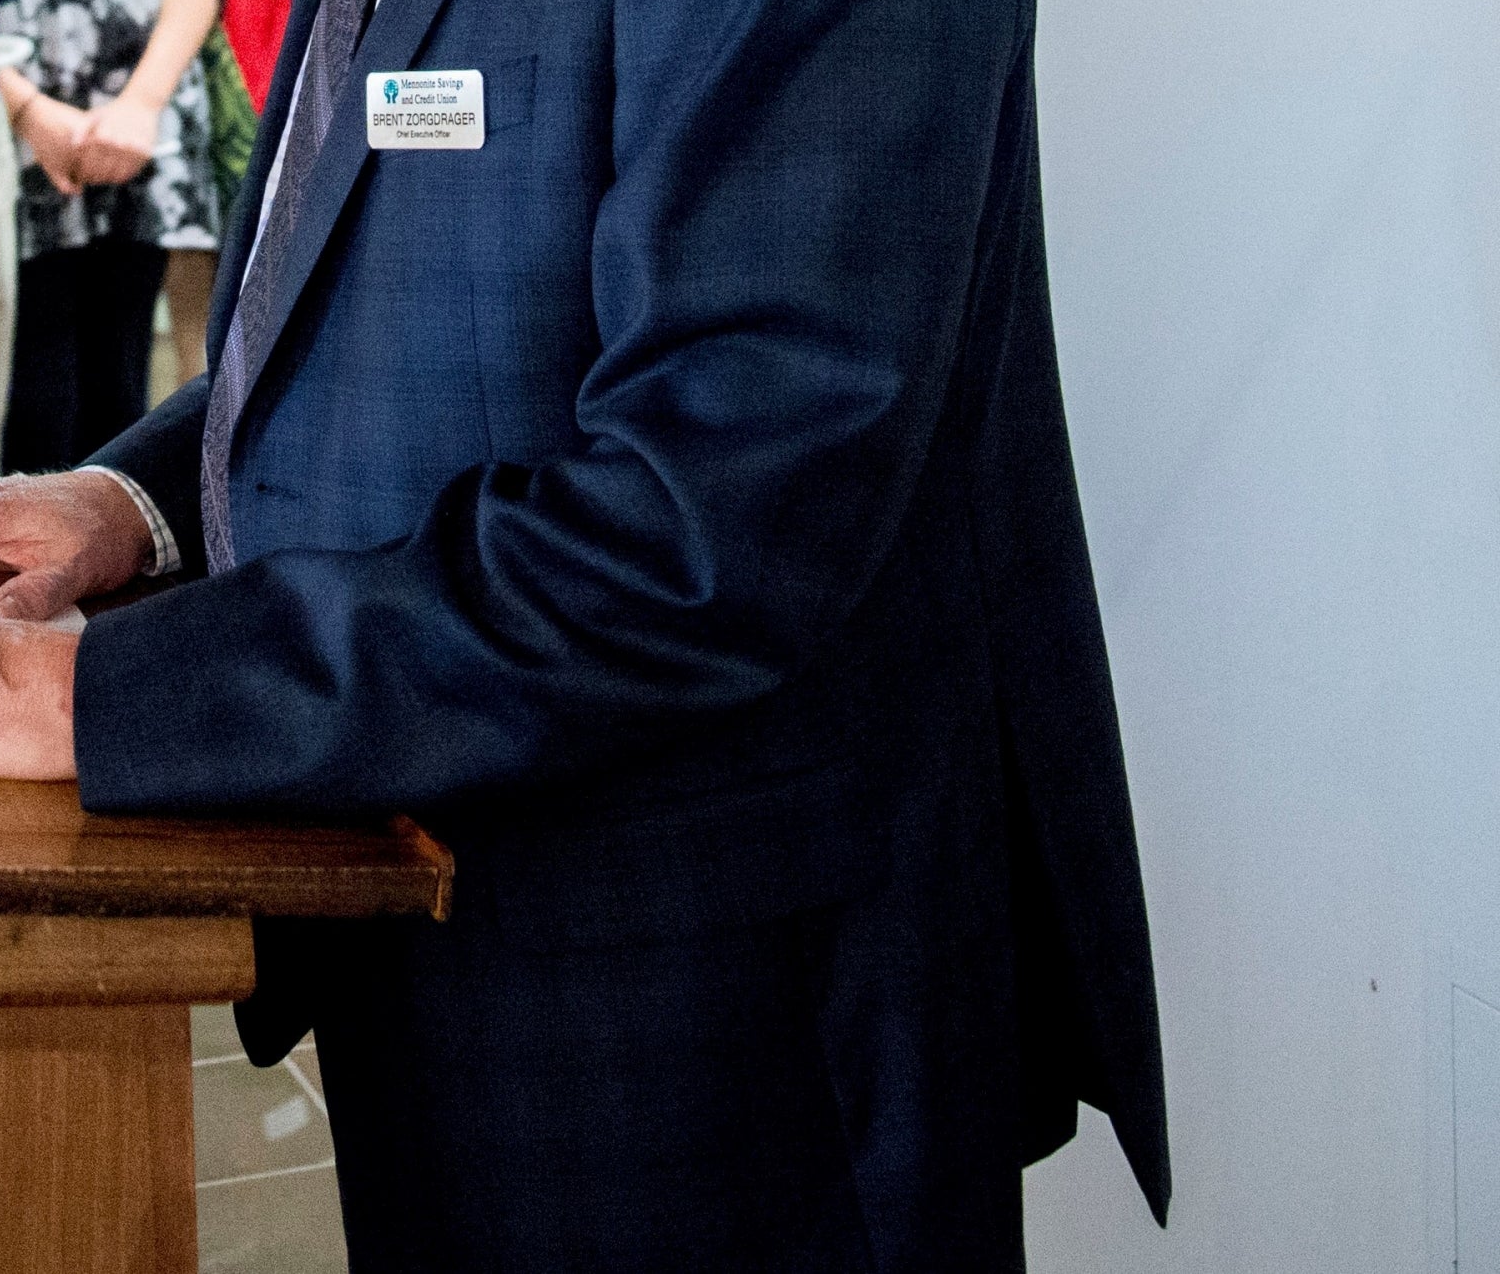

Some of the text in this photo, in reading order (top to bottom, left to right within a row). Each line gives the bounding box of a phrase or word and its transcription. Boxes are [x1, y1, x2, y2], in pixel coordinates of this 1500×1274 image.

[401, 77, 463, 90] Mennonite Savings
[402, 94, 457, 104] and Credit Union
[373, 112, 476, 126] BRENT ZORGDRAGER
[410, 130, 433, 138] Executive
[435, 129, 451, 138] Officer
